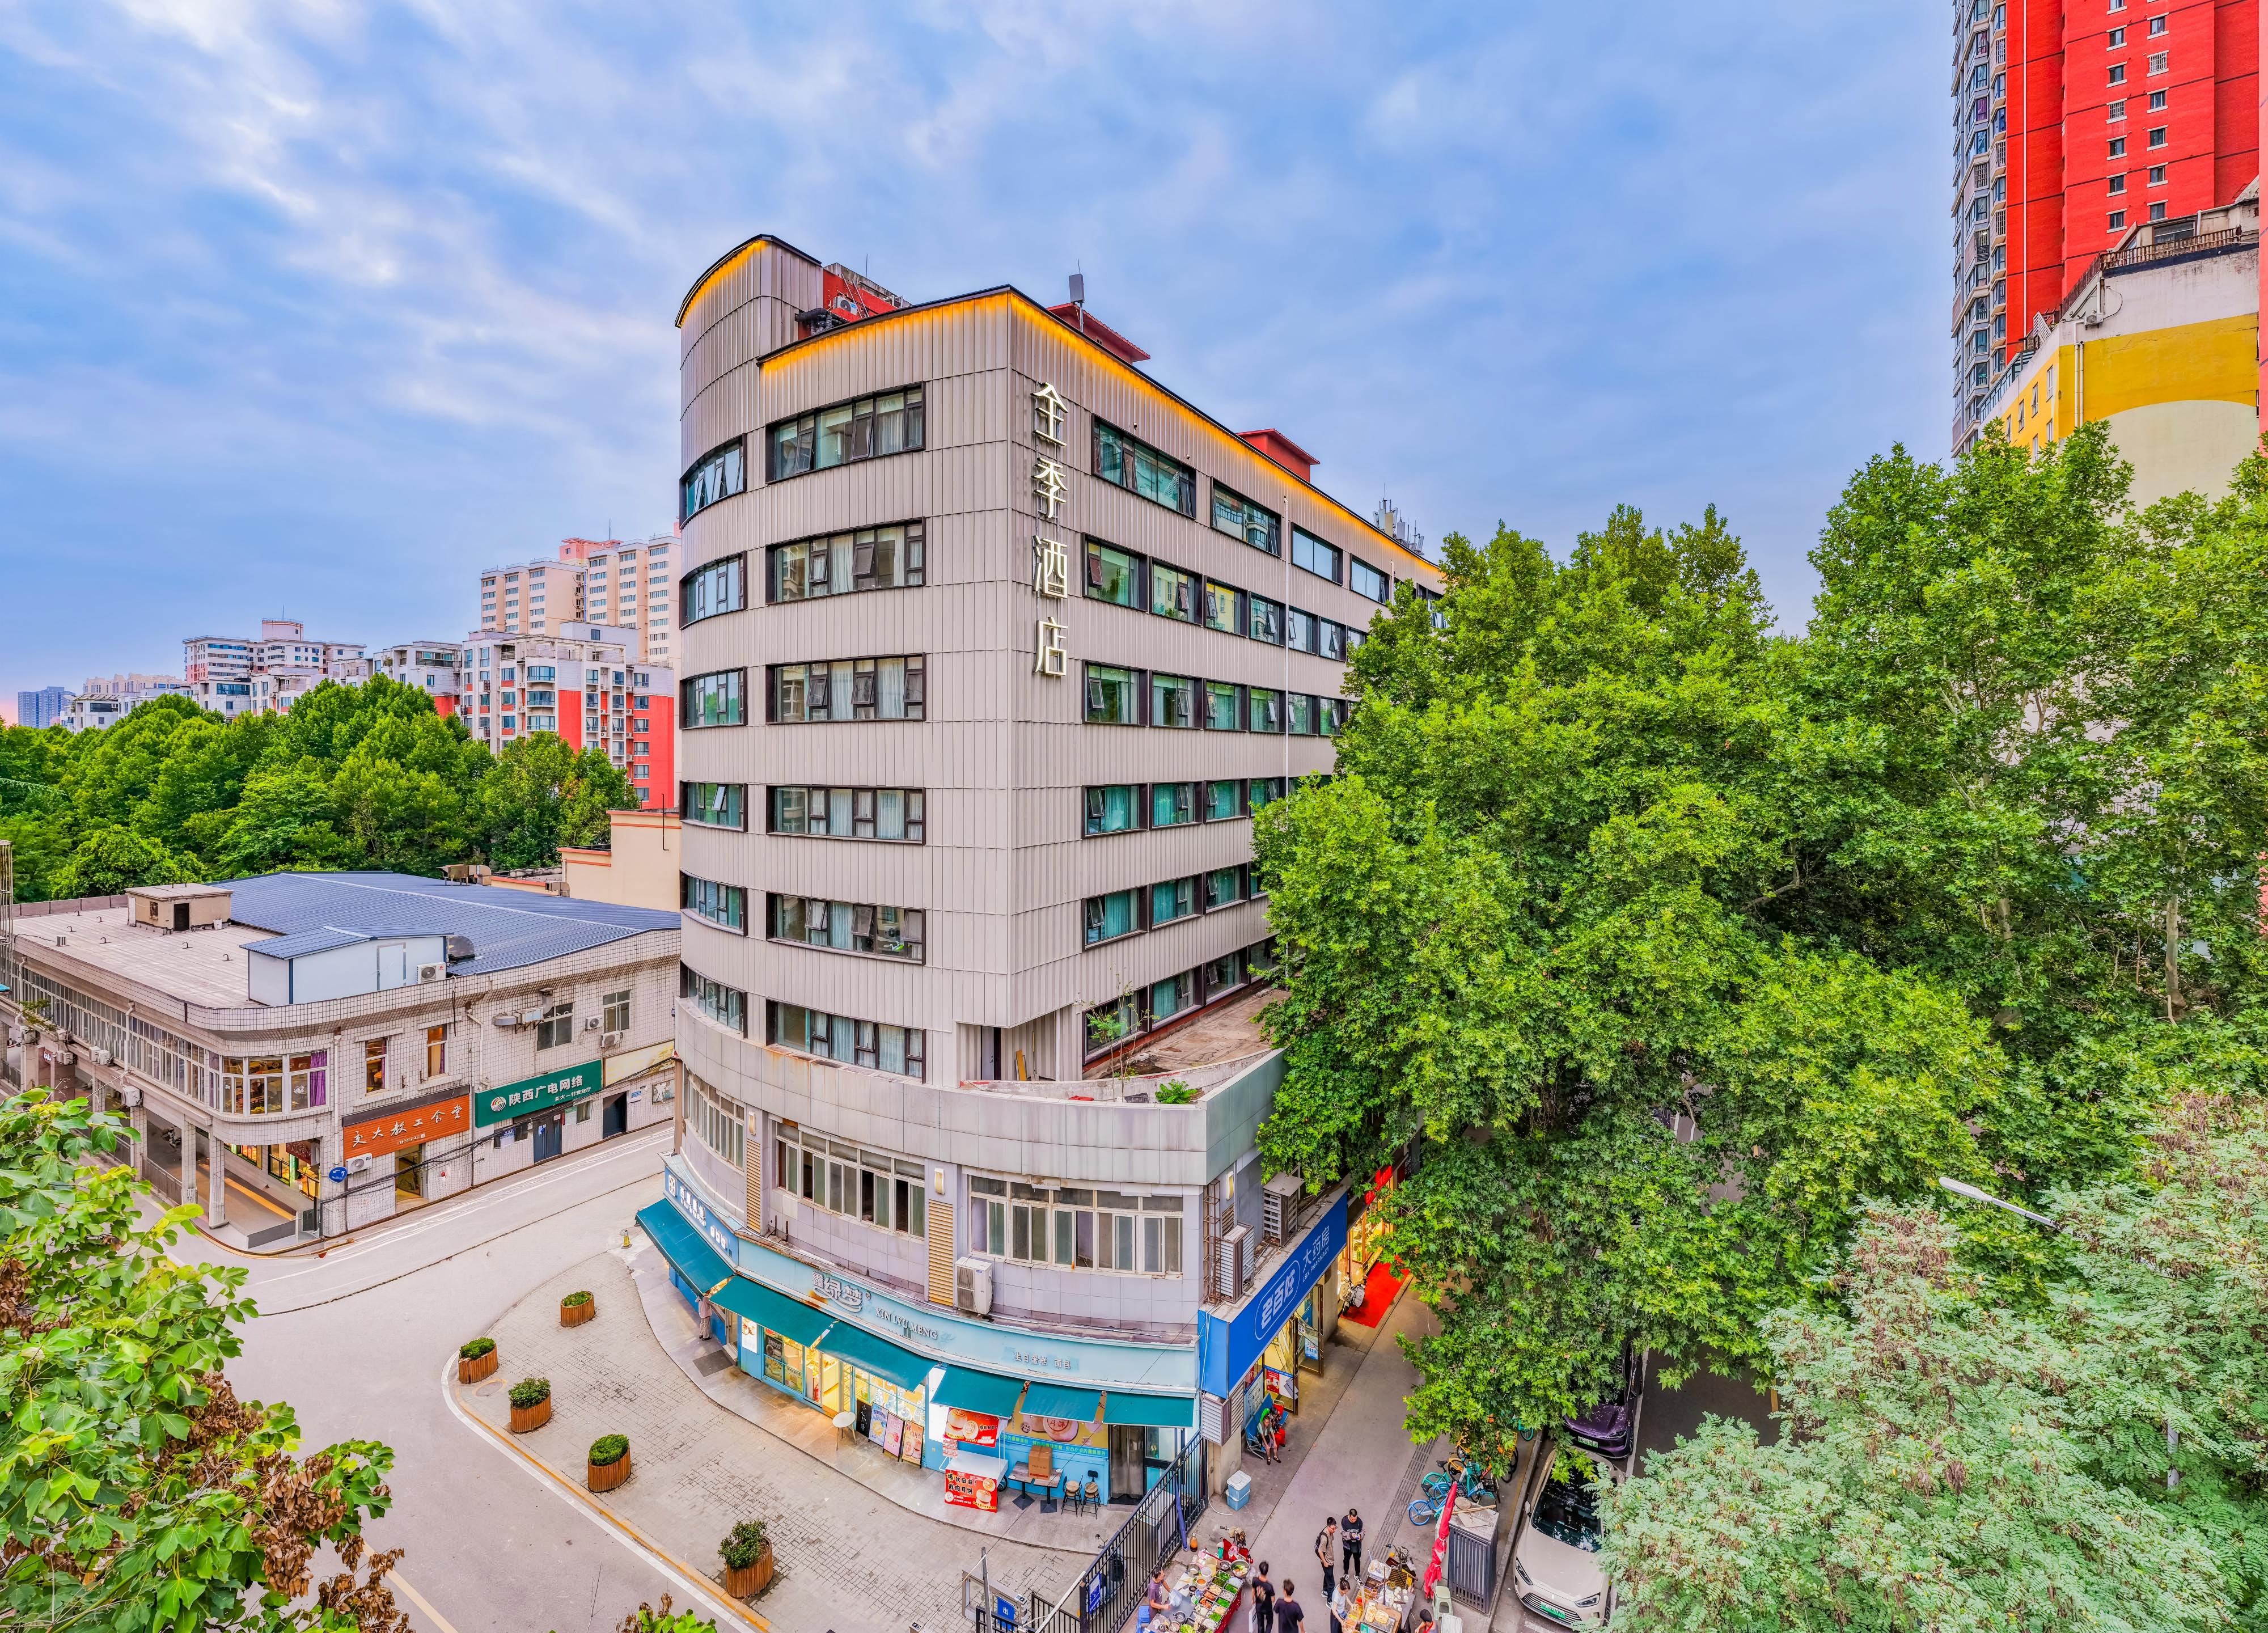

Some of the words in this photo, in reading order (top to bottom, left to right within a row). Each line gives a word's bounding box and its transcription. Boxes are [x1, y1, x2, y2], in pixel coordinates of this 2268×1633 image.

[1031, 382, 1068, 676] 全季酒店
[509, 1074, 583, 1107] 陕西广电网络
[352, 1104, 463, 1148] 交大教工食堂
[1302, 1225, 1330, 1274] 大药房
[1310, 1246, 1330, 1273] PHARMACY
[812, 1271, 863, 1313] 鑫绿梦
[1261, 1268, 1296, 1330] 老百姓
[875, 1306, 891, 1322] XIN
[892, 1315, 909, 1329] LYU
[909, 1322, 938, 1340] MENG
[1014, 1352, 1047, 1366] 生日蛋糕
[1054, 1358, 1071, 1369] 面包
[1002, 1607, 1008, 1615] 出
